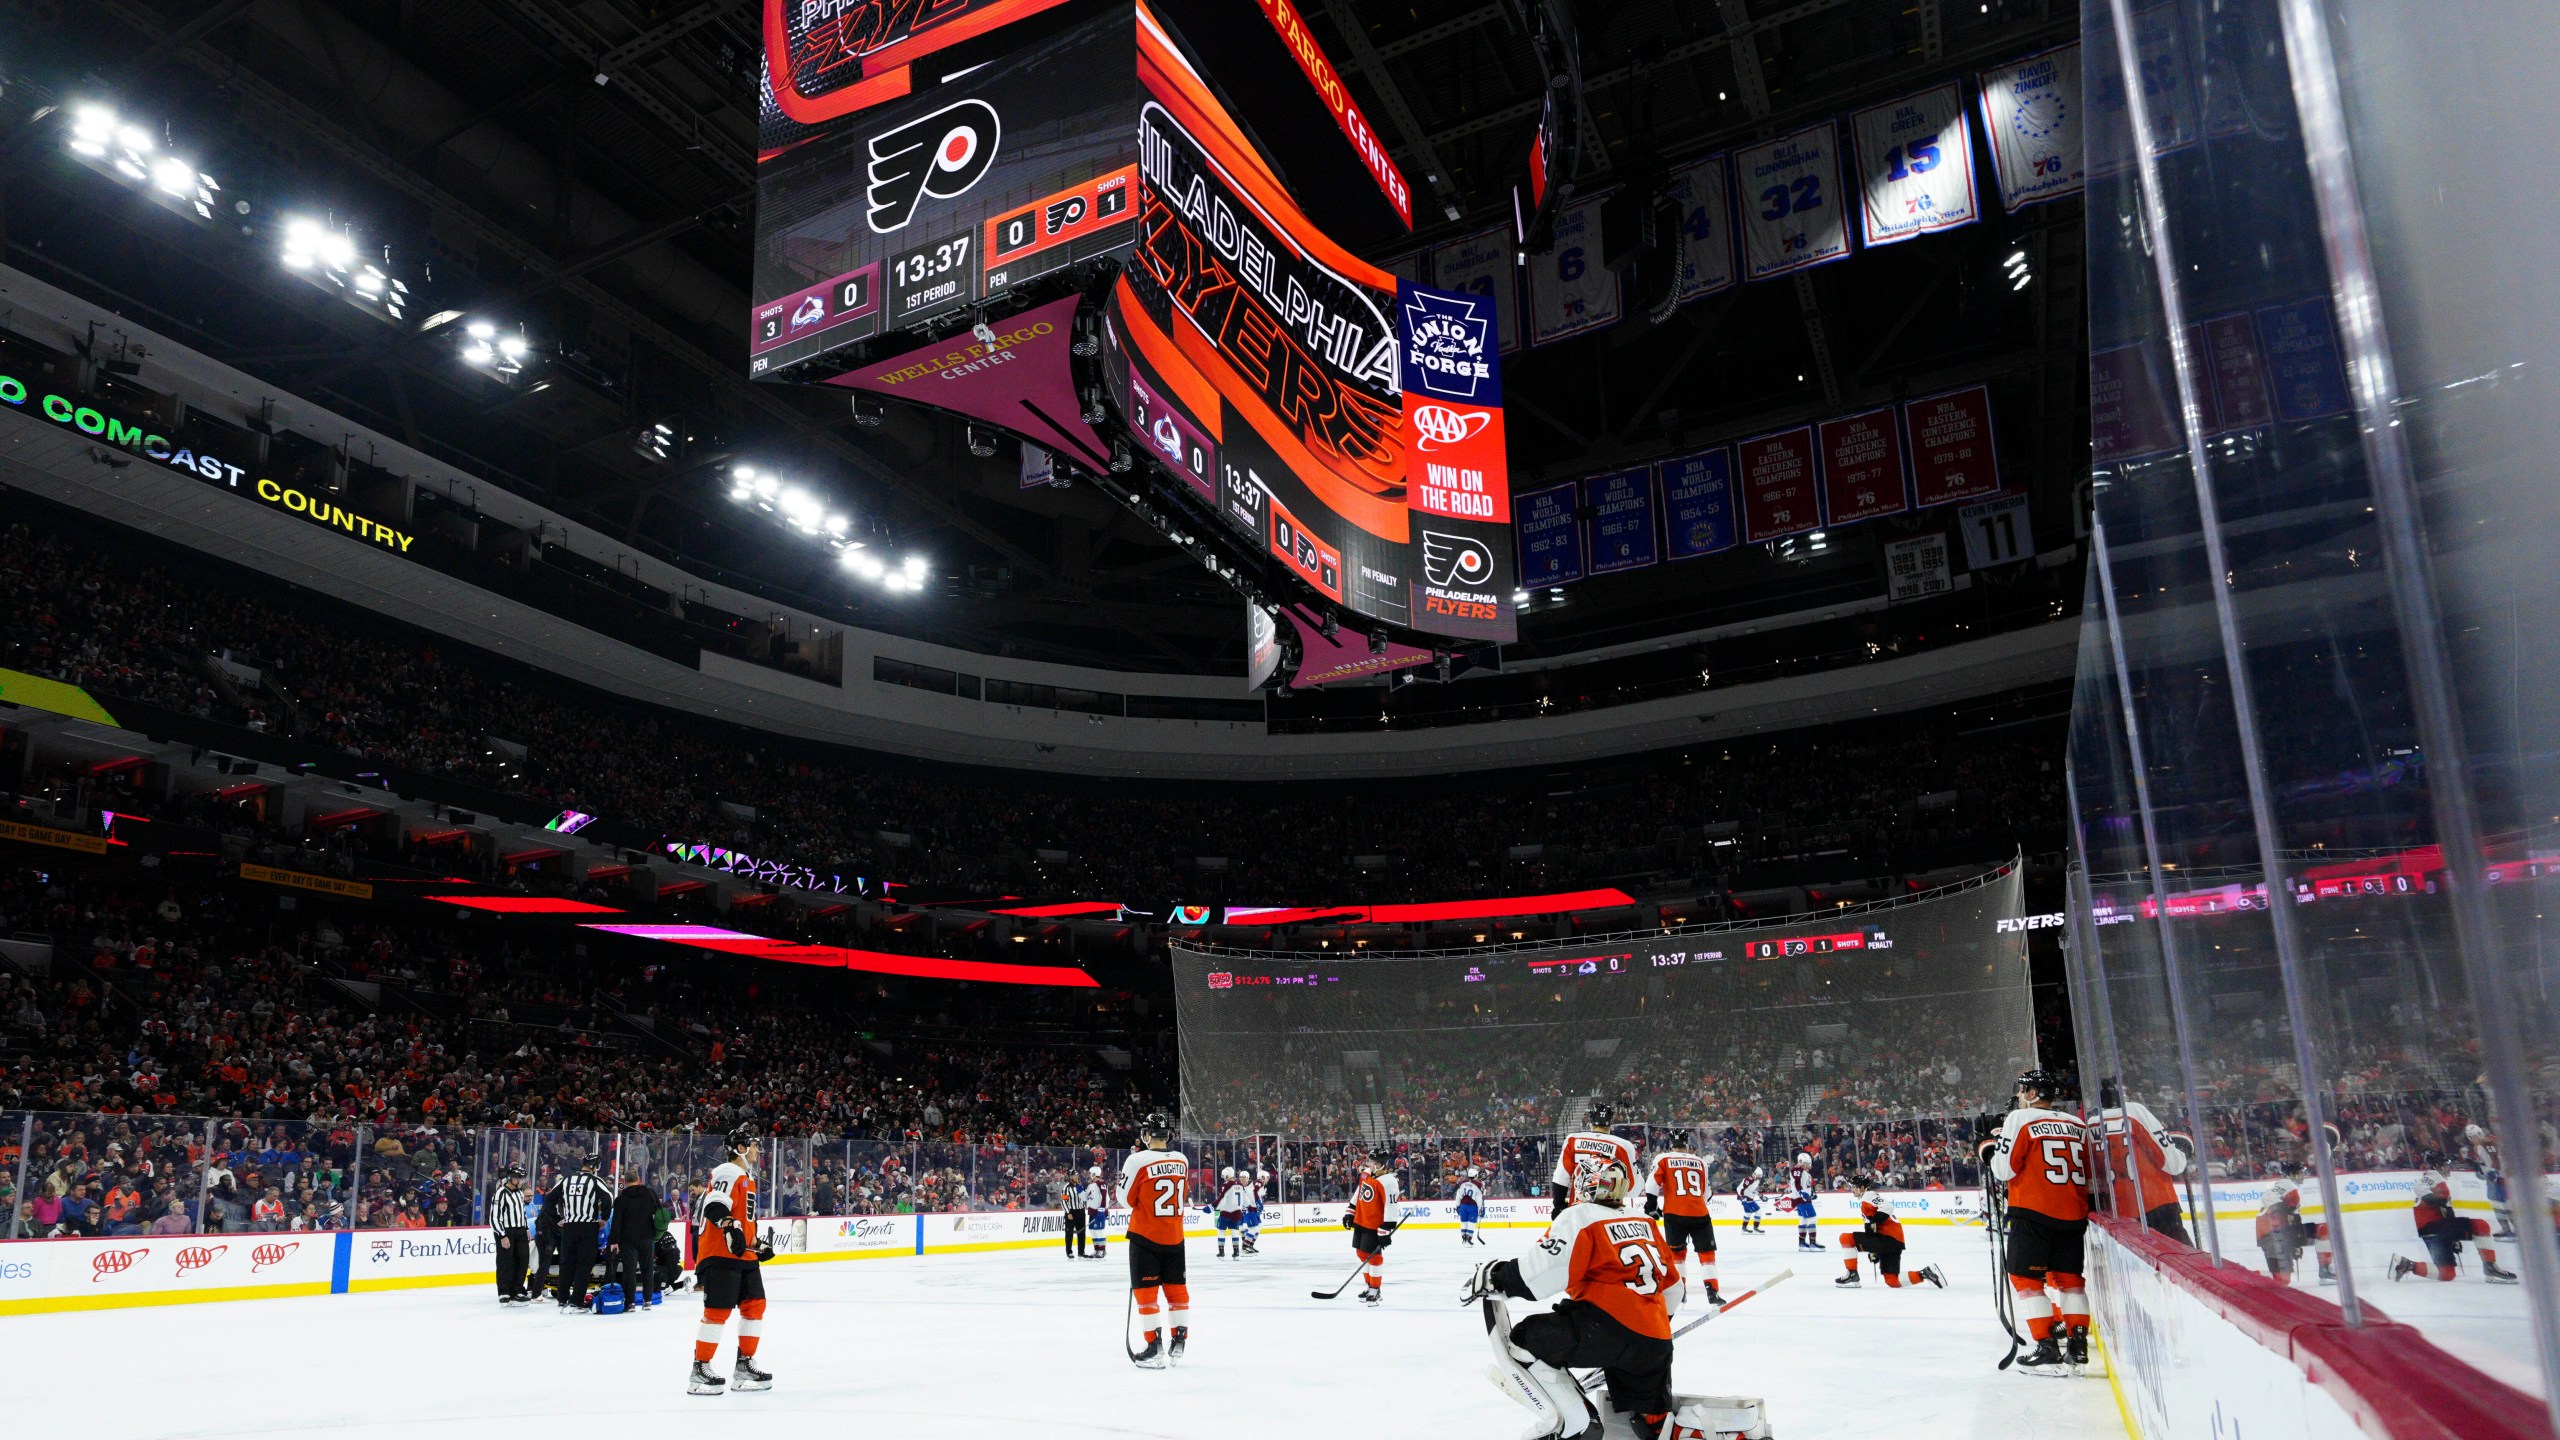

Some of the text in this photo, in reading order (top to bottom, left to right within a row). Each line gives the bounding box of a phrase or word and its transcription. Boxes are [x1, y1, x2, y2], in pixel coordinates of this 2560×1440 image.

[2018, 61, 2051, 81] DAVID
[2013, 71, 2058, 95] ZINKOFF
[1276, 1, 1408, 213] FARGO CENTER
[1895, 104, 1917, 121] HAL
[1891, 111, 1925, 133] GREER
[1773, 143, 1797, 160] BILLY
[1885, 135, 1941, 182] 15
[1754, 149, 1820, 178] CUNNINGHAM
[2033, 157, 2062, 177] 76
[1097, 175, 1126, 192] SHOTS
[1107, 194, 1115, 211] 1
[1761, 174, 1822, 222] 32
[1905, 194, 1932, 214] 76
[1878, 206, 1965, 235] Philadelphia 76ers
[1009, 221, 1023, 245] 0
[1461, 245, 1478, 258] WILT
[1782, 232, 1807, 254] 76
[895, 236, 969, 287] 13:37
[1444, 249, 1500, 274] CHAMBERLAIN
[1559, 246, 1585, 282] 6
[1755, 244, 1839, 273] Philadelphia 76ers
[990, 271, 1007, 288] PEN
[844, 283, 857, 306] 0
[906, 281, 956, 309] 1ST PERIOD
[760, 304, 784, 320] SHOTS
[1436, 314, 1453, 322] THE
[1563, 301, 1585, 318] 76
[766, 321, 776, 337] 3
[1541, 319, 1589, 338] Philadelphia
[1412, 320, 1483, 357] UNION
[1430, 340, 1467, 355] Vodka
[753, 358, 768, 373] PEN
[877, 352, 966, 386] WELLS
[941, 350, 1016, 380] CENTER
[1410, 351, 1490, 378] FORGE
[1133, 380, 1149, 405] SHOTS
[1138, 406, 1145, 425] 3
[1937, 402, 1955, 413] NBA
[1416, 407, 1466, 443] AAA
[1928, 409, 1967, 426] EASTERN
[1850, 422, 1867, 433] NBA
[1921, 417, 1977, 437] CONFERENCE
[1840, 428, 1879, 446] EASTERN
[1924, 429, 1976, 448] CHAMPIONS
[1767, 441, 1783, 452] NBA
[1835, 438, 1887, 458] CONFERENCE
[1193, 447, 1203, 474] 0
[1758, 449, 1794, 466] EASTERN
[1838, 450, 1886, 467] CHAMPIONS
[43, 394, 414, 552] COMCAST COUNTRY
[1684, 462, 1705, 475] NBA
[1752, 458, 1802, 477] CONFERENCE
[1427, 463, 1483, 492] WIN ON
[1609, 477, 1628, 490] NBA
[1681, 471, 1712, 487] WORLD
[1755, 469, 1801, 486] CHAMPIONS
[1945, 472, 1965, 487] 76
[1225, 464, 1261, 511] 13:37
[1604, 488, 1634, 502] WORLD
[1671, 480, 1724, 500] CHAMPIONS
[1420, 485, 1494, 517] THE ROAD
[1536, 496, 1553, 508] NBA
[1856, 491, 1876, 506] 76
[1232, 499, 1255, 527] 1ST PERIOD
[1532, 505, 1561, 519] WORLD
[1772, 510, 1791, 524] 76
[1962, 503, 1986, 518] KEVIN
[1523, 513, 1572, 534] CHAMPIONS
[1280, 522, 1289, 547] 0
[1979, 513, 2017, 561] 11
[1320, 550, 1337, 566] SHOTS
[1326, 569, 1332, 585] 1
[1361, 565, 1398, 588] PHI PENALTY
[1426, 587, 1497, 604] PHILADELPHIA
[1426, 596, 1498, 620] FLYERS
[29, 828, 52, 843] GAME
[270, 871, 291, 885] EVERY
[1996, 912, 2065, 934] FLYERS
[1820, 939, 1859, 950] 1 SHOTS
[1868, 939, 1893, 950] PENALTY
[1874, 932, 1885, 940] PHI
[1650, 952, 1687, 967] 13:37
[1705, 951, 1722, 960] PERIOD
[1762, 944, 1771, 957] 0
[1561, 965, 1567, 974] 3
[1610, 959, 1618, 971] 0
[1292, 977, 1304, 985] PM
[1464, 973, 1486, 982] PENALTY
[1577, 1141, 1614, 1154] JOHNSON
[2042, 1140, 2086, 1185] 55
[569, 1183, 584, 1195] 83
[1674, 1169, 1702, 1197] 19
[1154, 1178, 1184, 1217] 21
[1234, 1192, 1241, 1207] 7
[1849, 1199, 1917, 1209] Indence
[856, 1219, 895, 1239] Sports
[968, 1223, 1003, 1231] ACTIVE CASH
[1023, 1215, 1066, 1233] PLAY ONLINE
[176, 1246, 212, 1268] AAA
[252, 1243, 285, 1266] AAA
[399, 1240, 441, 1258] Penn
[93, 1250, 132, 1273] AAA
